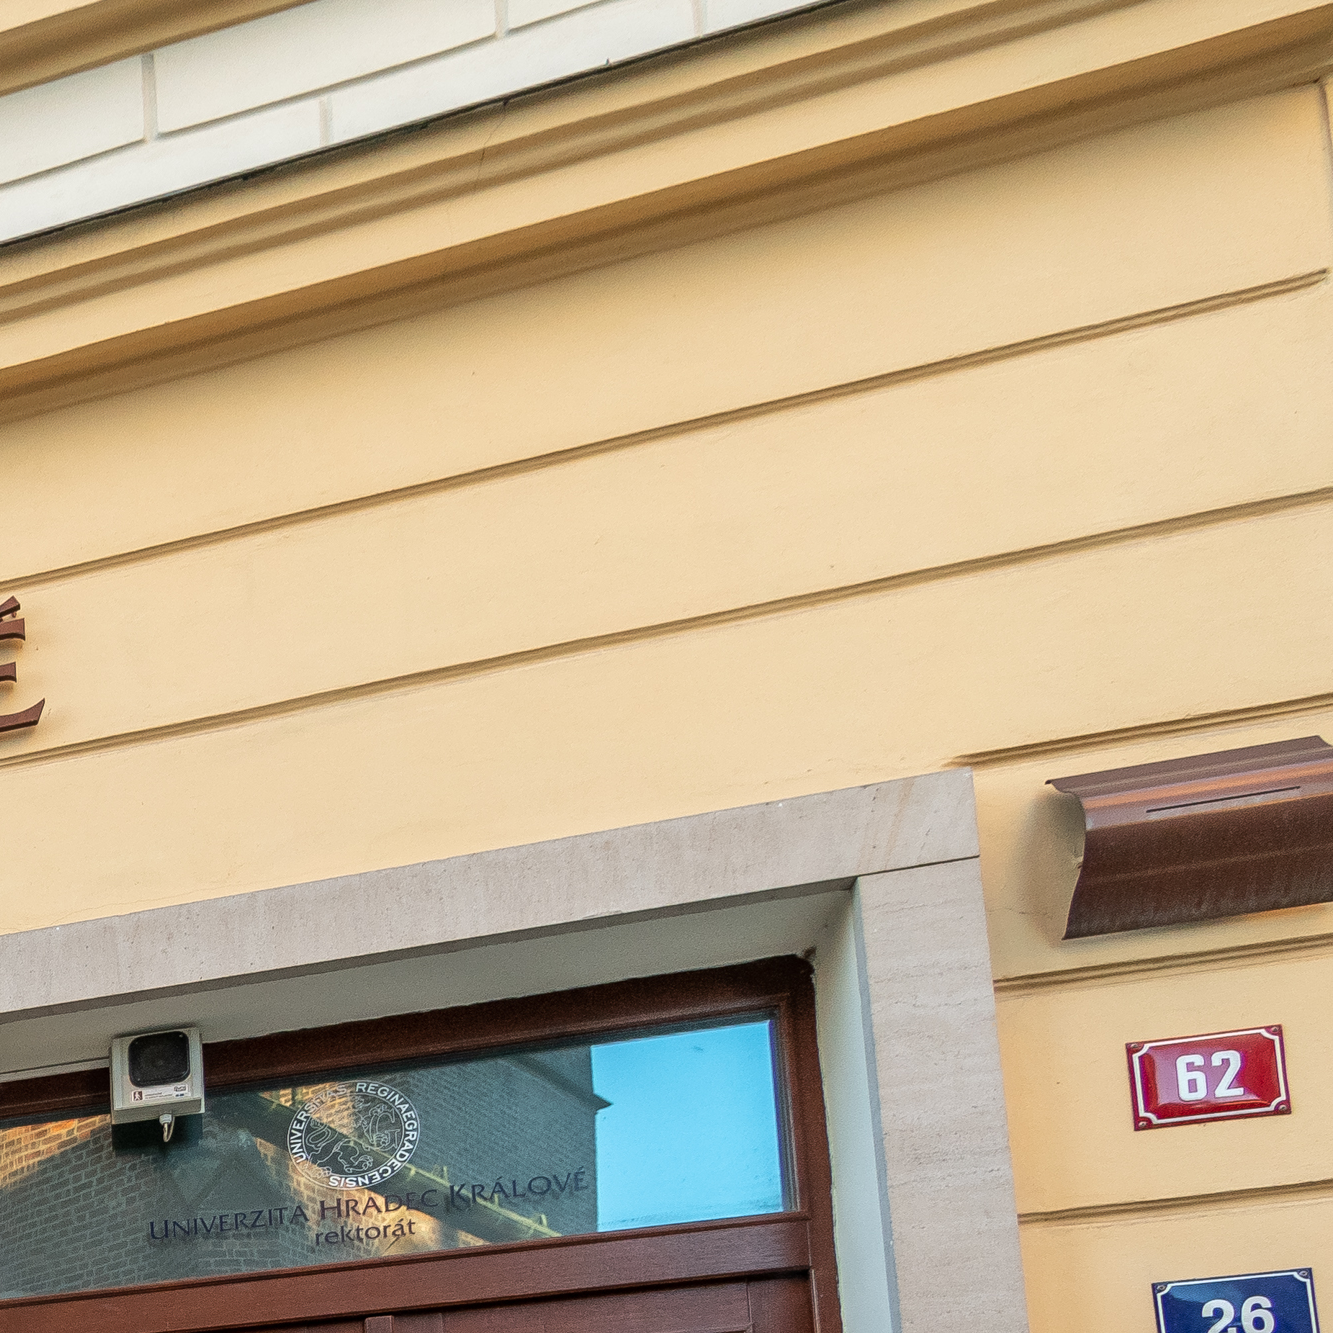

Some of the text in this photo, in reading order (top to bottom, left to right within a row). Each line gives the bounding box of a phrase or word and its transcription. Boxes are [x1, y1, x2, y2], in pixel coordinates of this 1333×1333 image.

[1175, 1049, 1245, 1102] 62
[290, 1084, 348, 1163] UNIVERSITAS
[148, 1166, 589, 1240] UNIVERZITA HRADEC KRÁLOVÉ
[315, 1217, 417, 1246] rektorát
